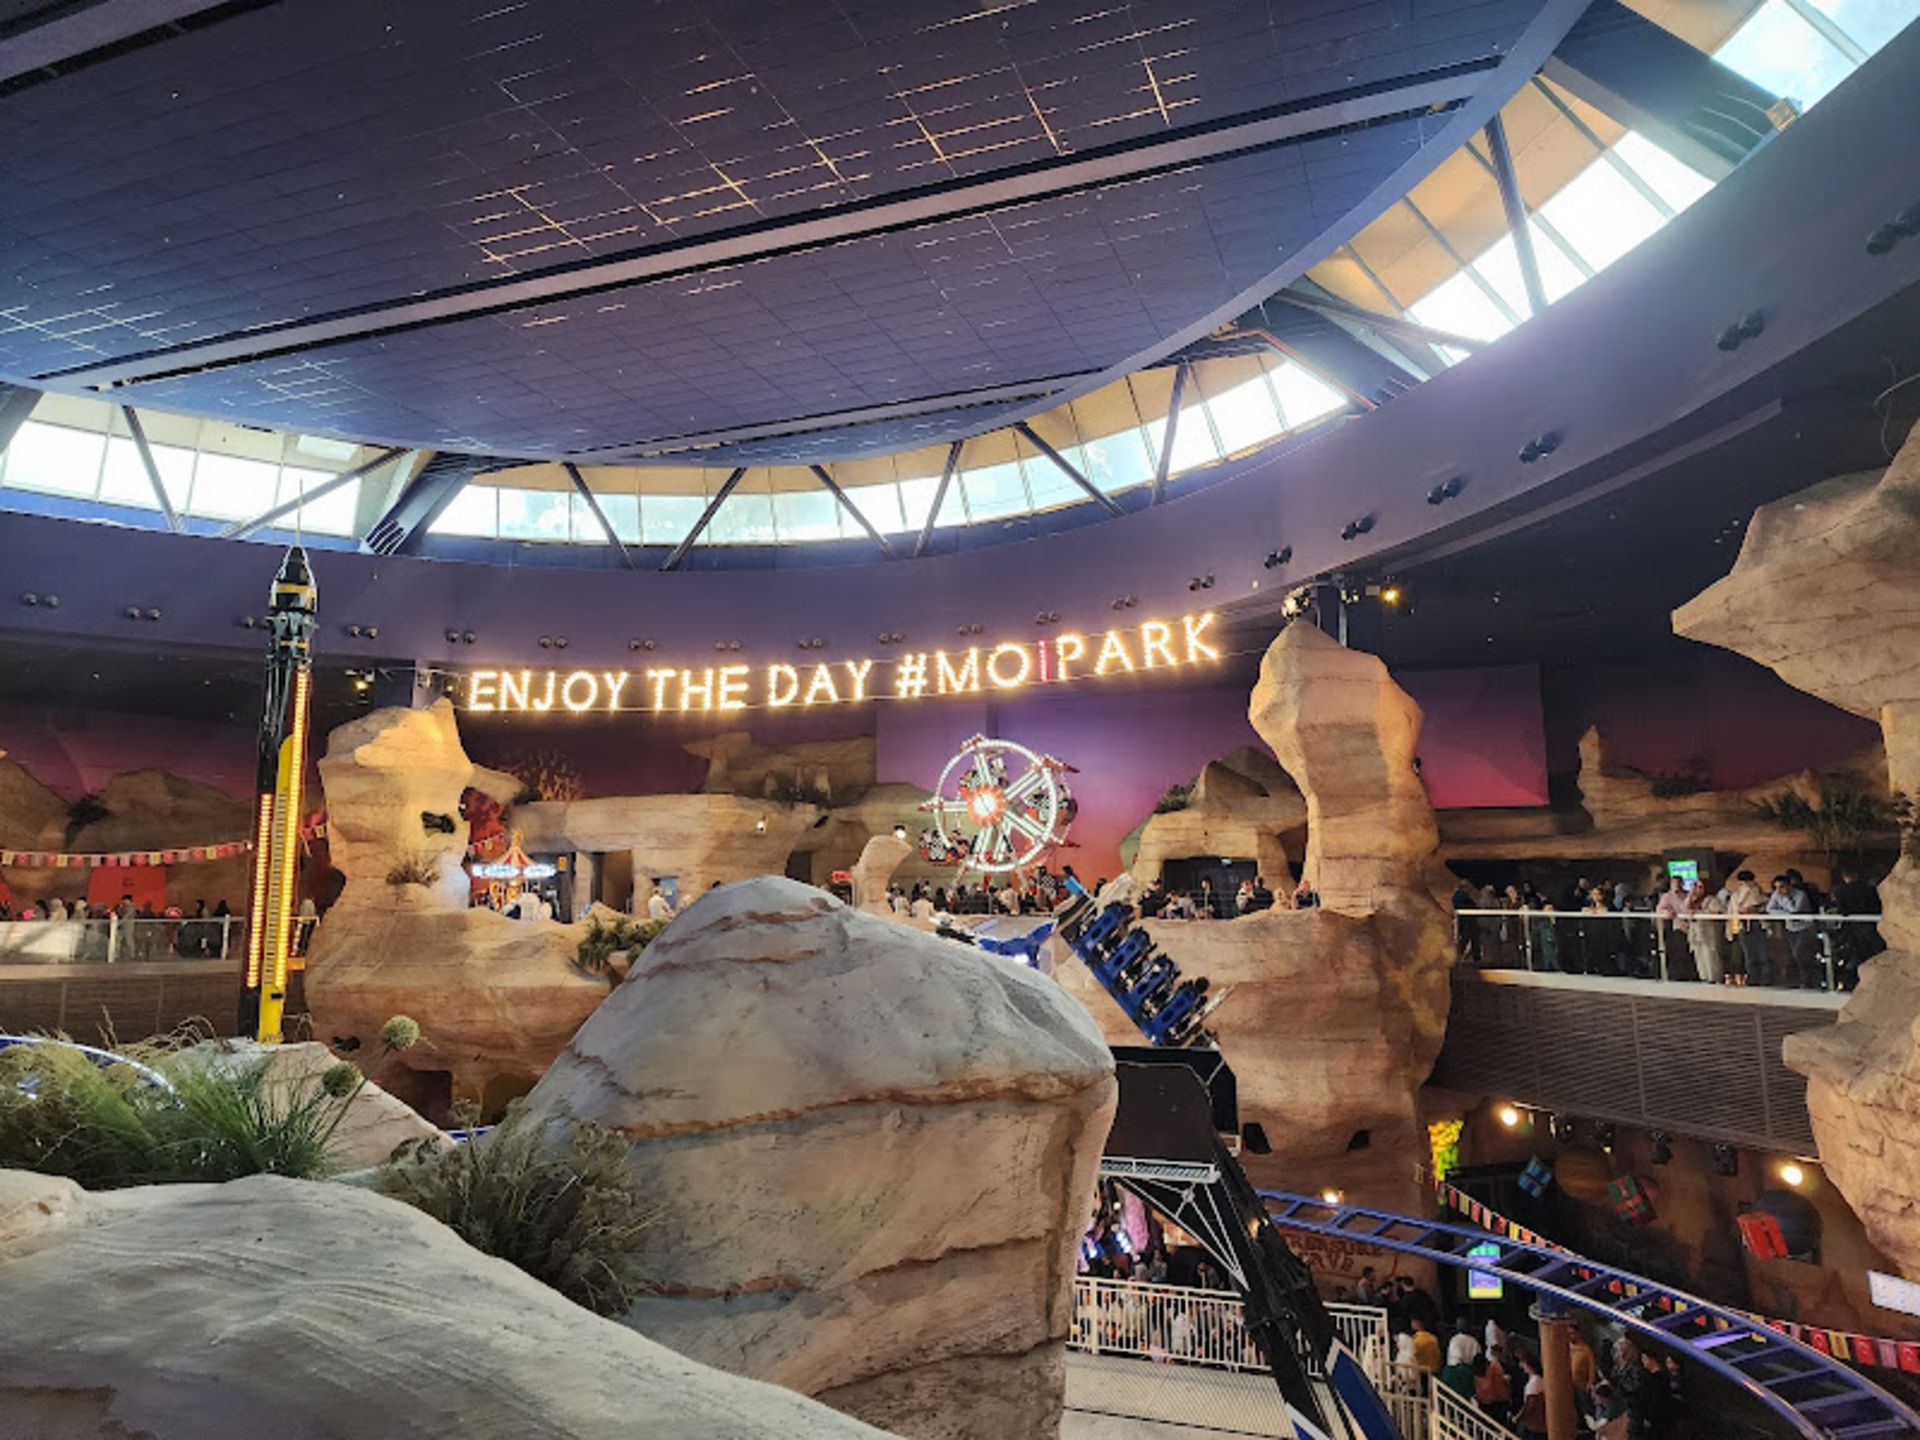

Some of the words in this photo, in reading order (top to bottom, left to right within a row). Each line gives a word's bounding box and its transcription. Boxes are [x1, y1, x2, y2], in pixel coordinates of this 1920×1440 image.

[468, 669, 629, 712] ENJOY
[646, 664, 750, 711] THE
[767, 658, 873, 707] DAY
